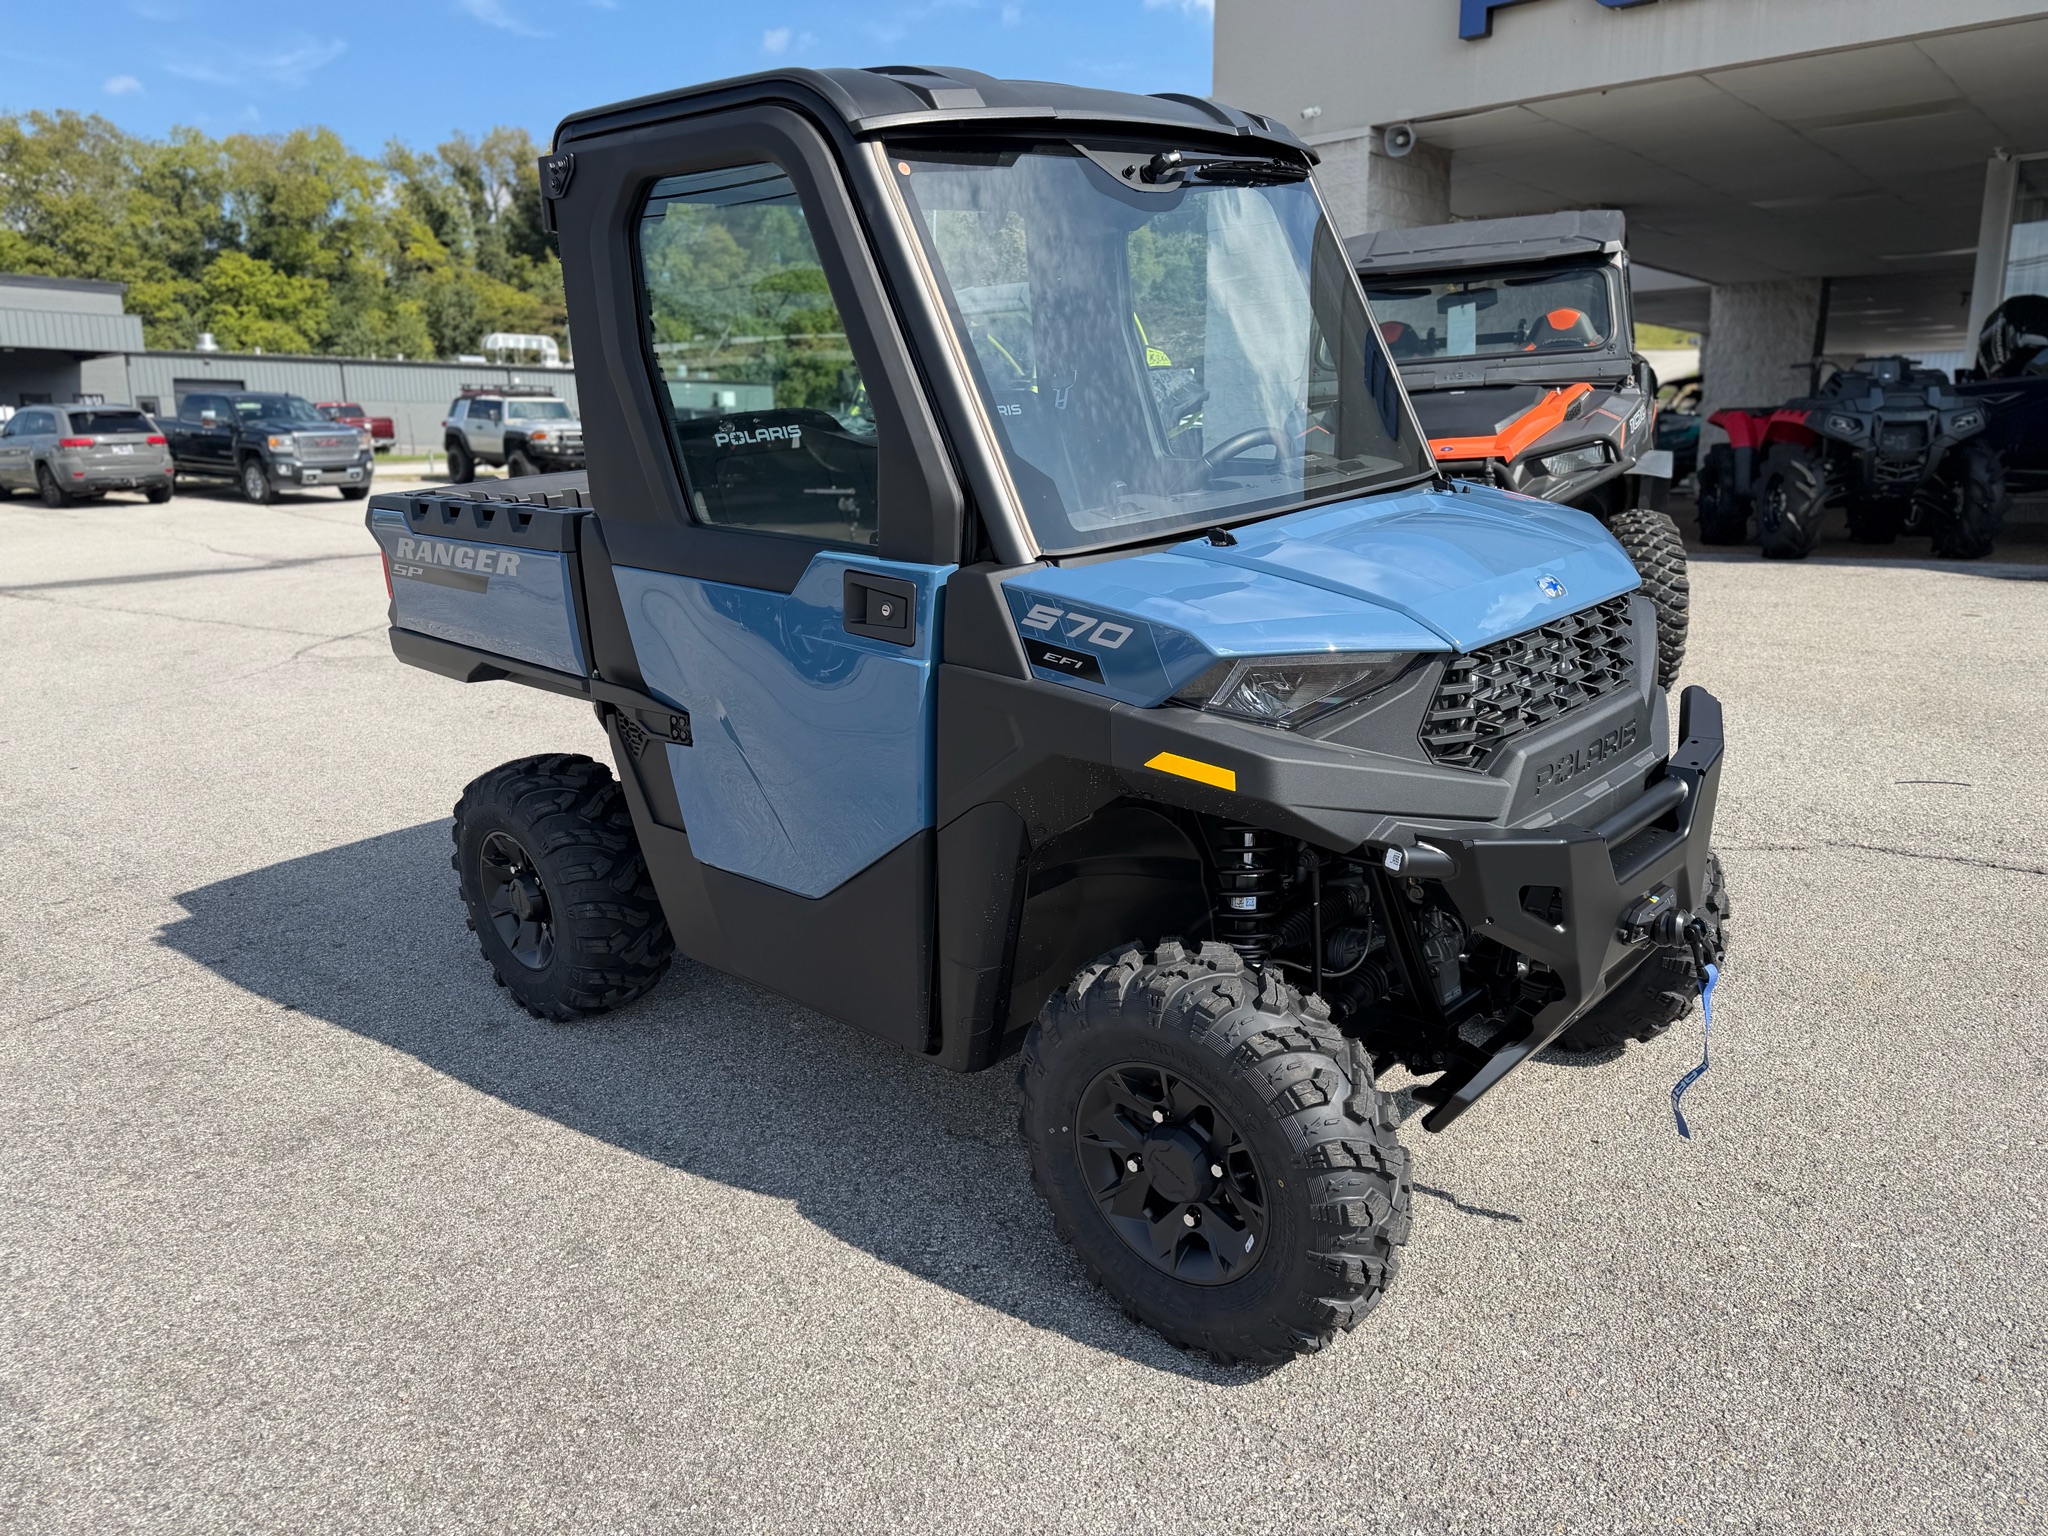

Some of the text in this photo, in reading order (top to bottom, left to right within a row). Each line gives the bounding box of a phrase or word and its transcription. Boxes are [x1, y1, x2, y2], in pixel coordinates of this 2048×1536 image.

[714, 424, 802, 447] POLARIS
[393, 563, 424, 577] SP
[396, 537, 521, 577] RANGER
[1021, 603, 1134, 650] 570
[1043, 652, 1083, 669] EFI
[1535, 718, 1637, 798] POLARIS
